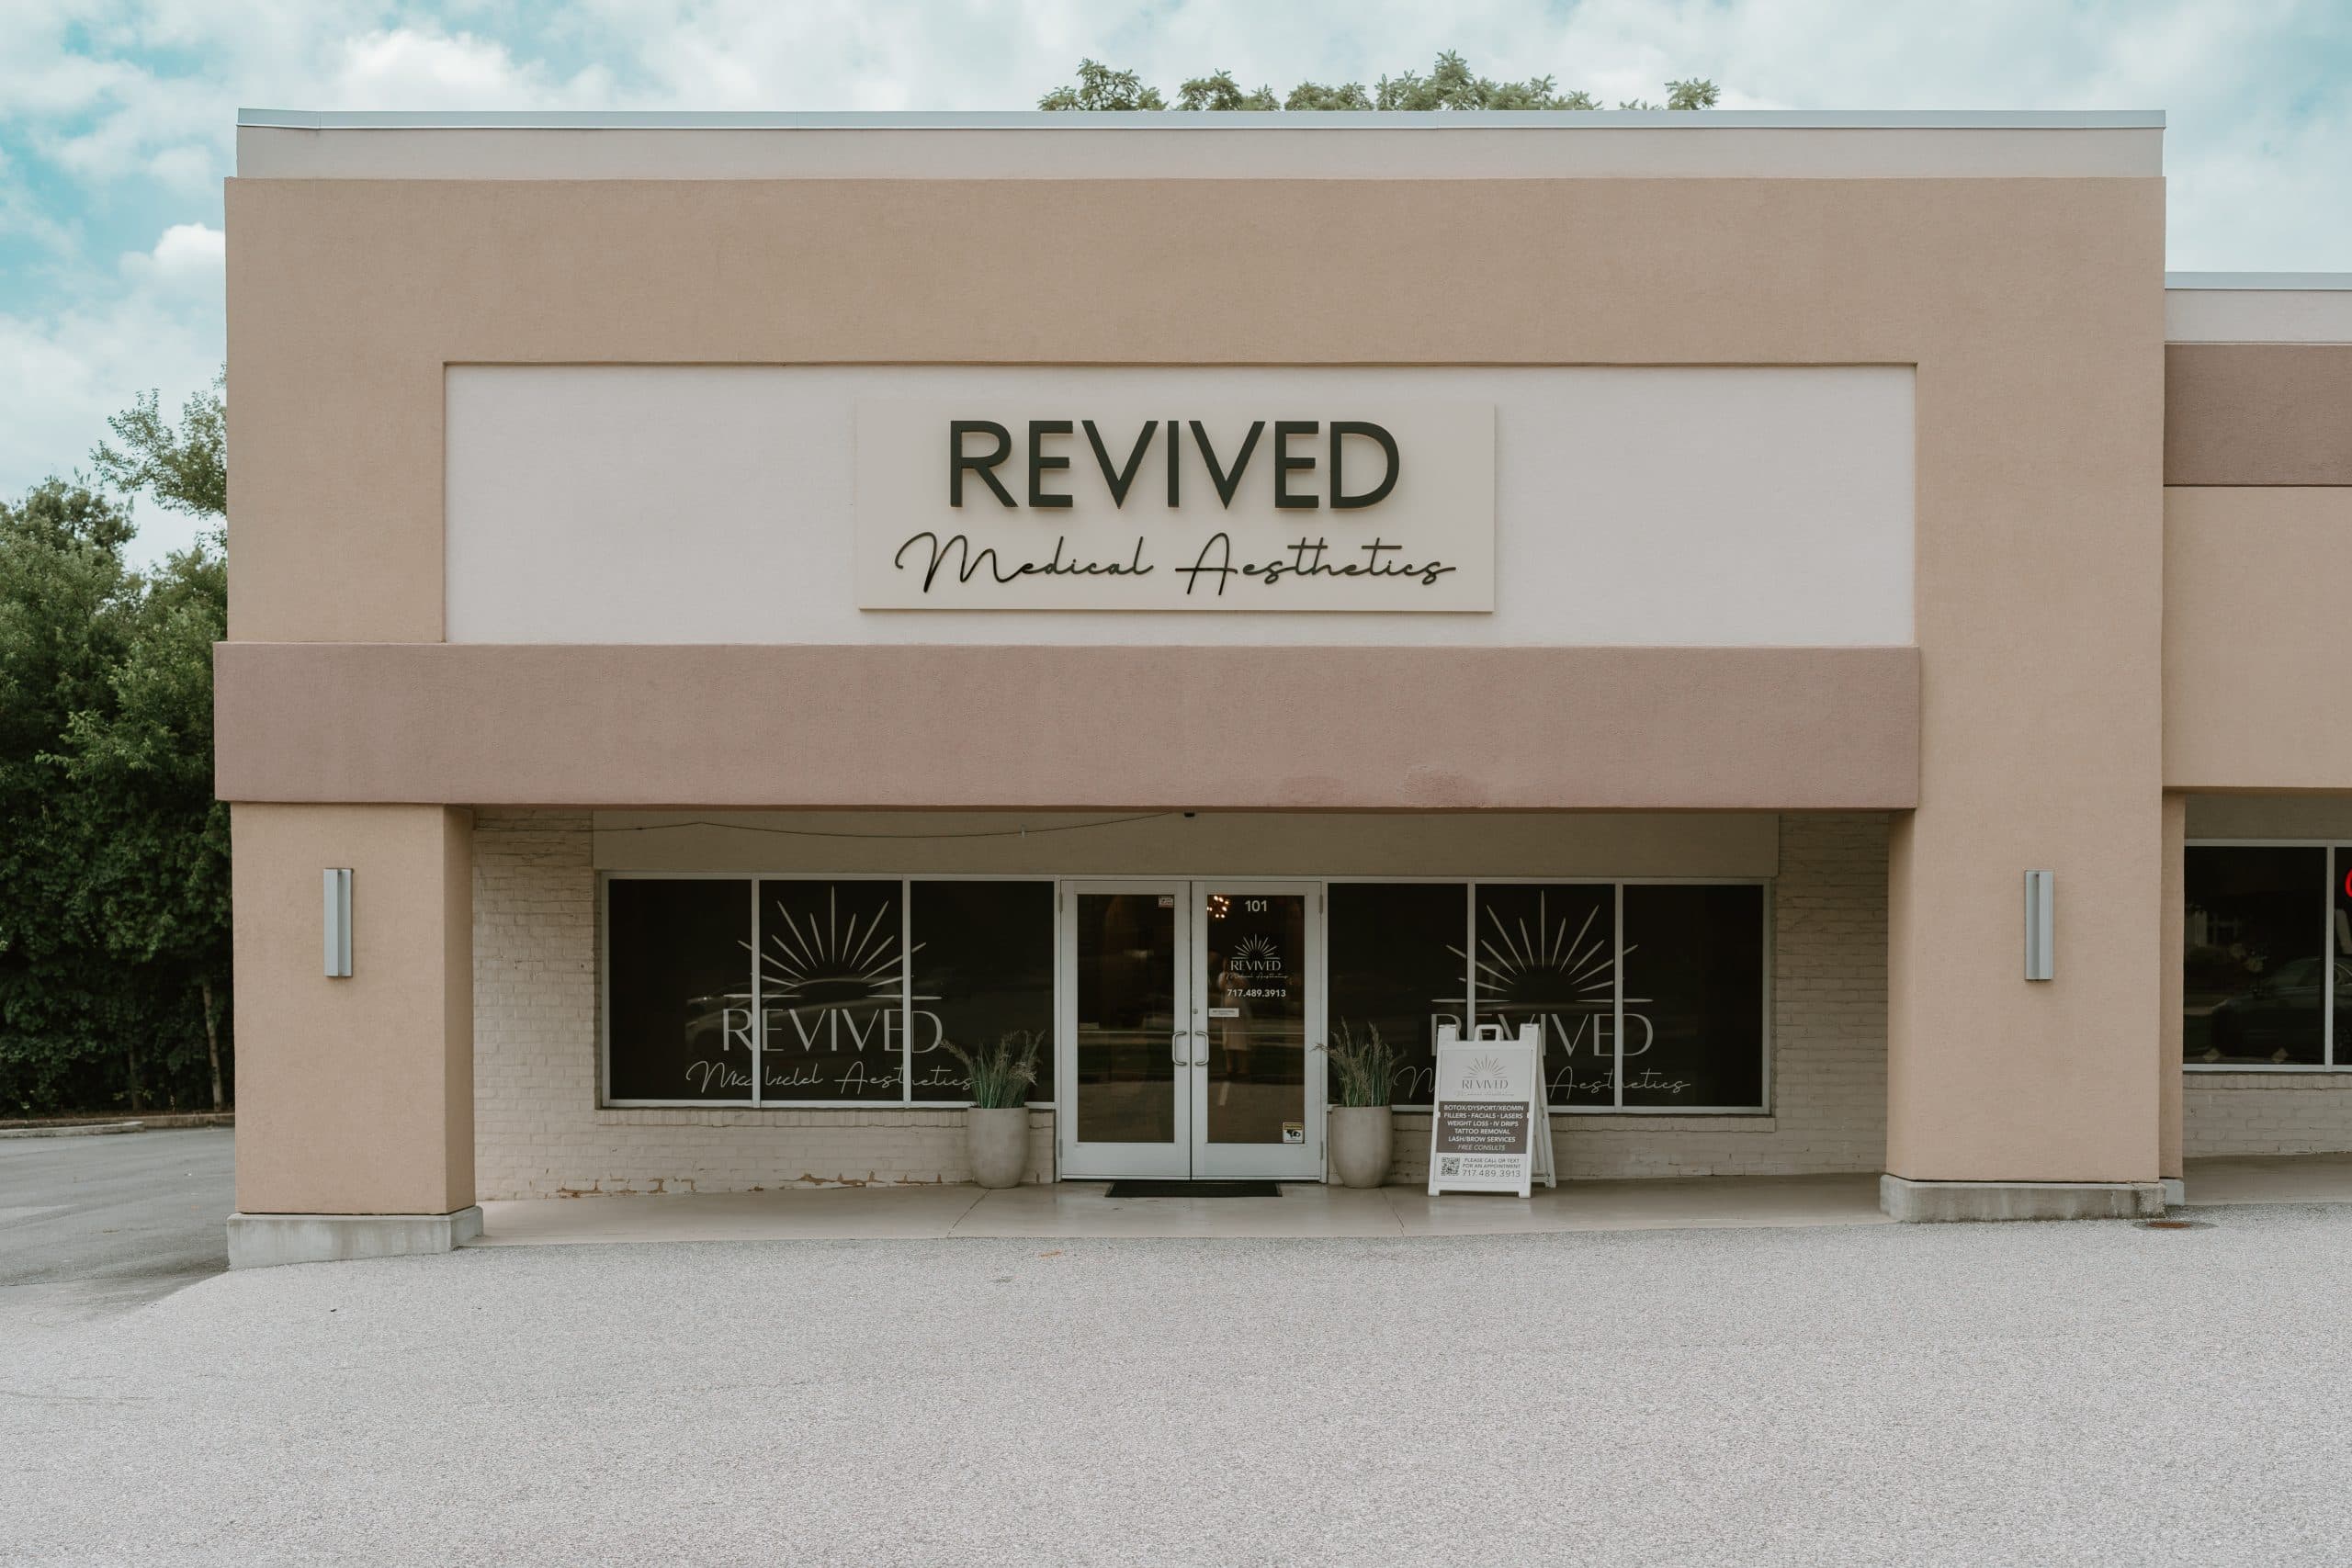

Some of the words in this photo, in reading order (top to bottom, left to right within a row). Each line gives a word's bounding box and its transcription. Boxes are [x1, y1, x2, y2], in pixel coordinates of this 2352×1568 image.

[950, 420, 1400, 509] REVIVED
[895, 532, 1155, 593] Medical
[1175, 532, 1457, 595] Aesthetics
[1245, 900, 1267, 912] 101
[1231, 960, 1282, 971] REVIVED
[1227, 988, 1286, 998] 717.489.3913
[723, 1009, 943, 1054] REVIVED
[834, 1060, 981, 1095] Aestetics
[1545, 1066, 1690, 1100] Aestetics
